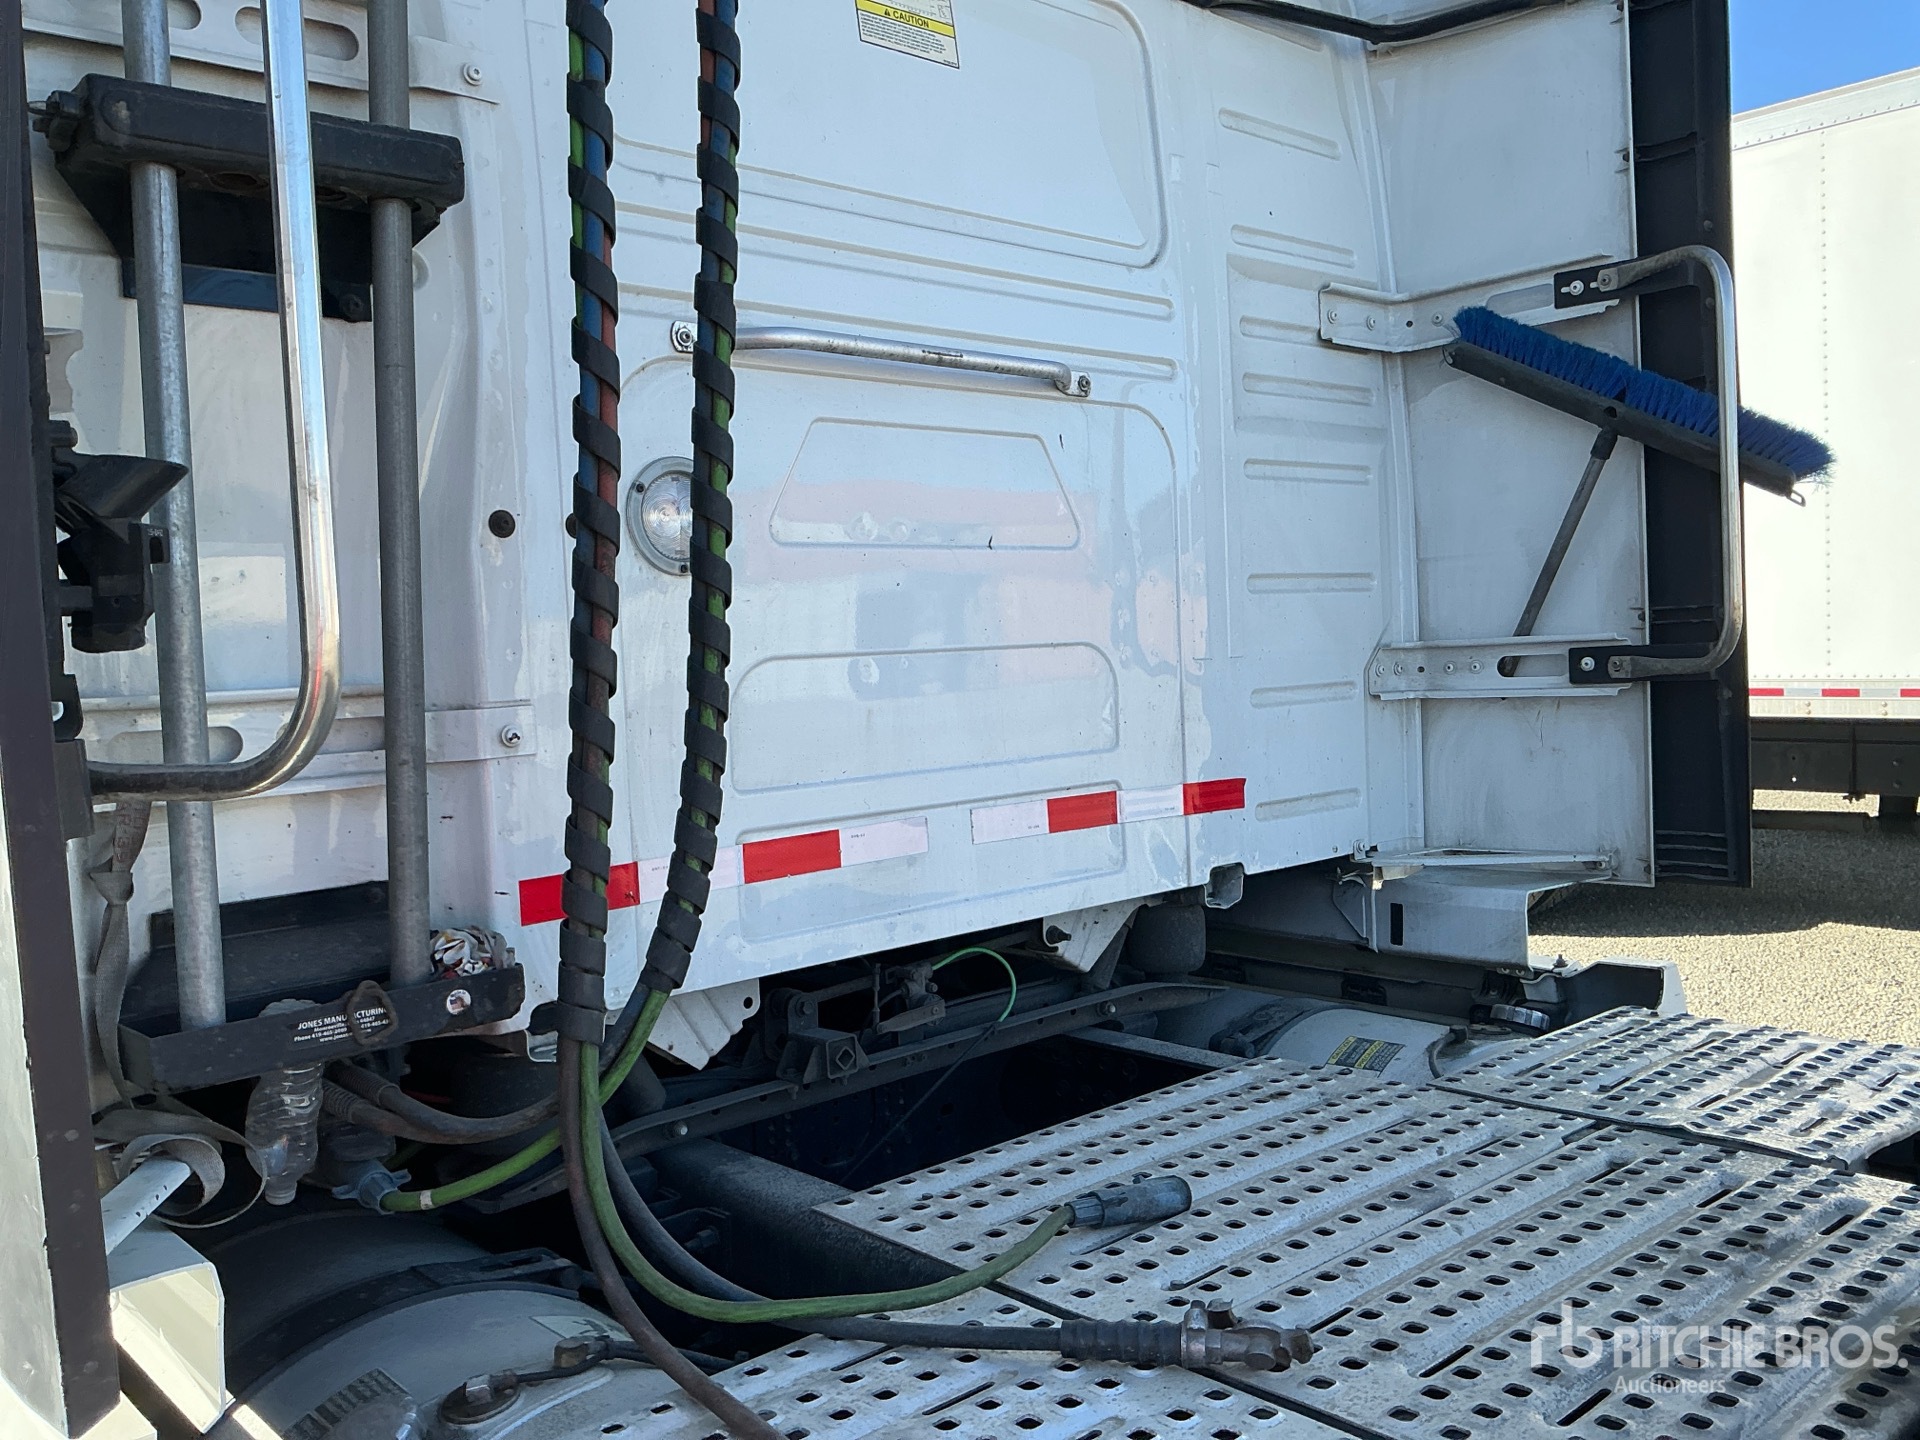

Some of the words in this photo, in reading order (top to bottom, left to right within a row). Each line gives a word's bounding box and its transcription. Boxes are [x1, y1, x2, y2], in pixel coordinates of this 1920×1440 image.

[893, 10, 930, 28] CAUTION
[298, 1019, 323, 1030] JONES
[324, 1007, 387, 1025] MANUCTURIN
